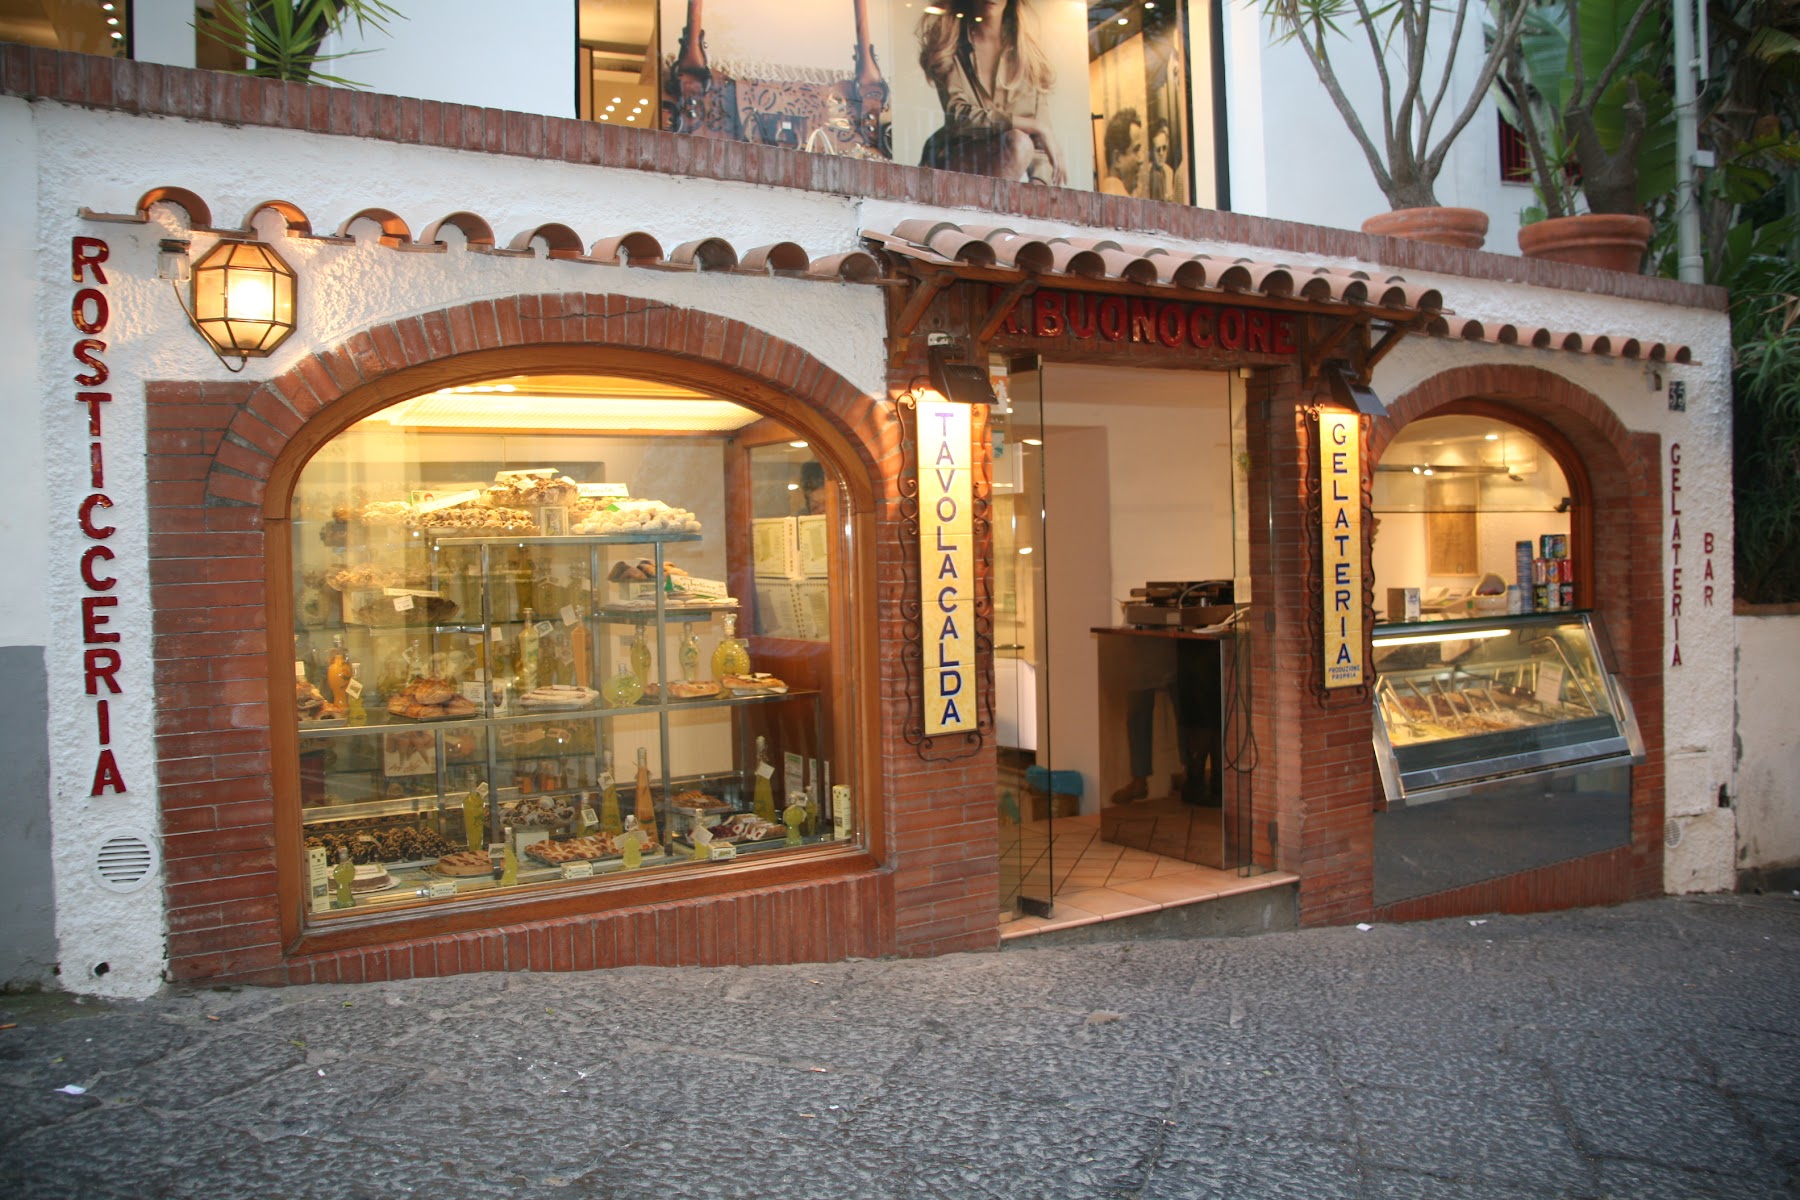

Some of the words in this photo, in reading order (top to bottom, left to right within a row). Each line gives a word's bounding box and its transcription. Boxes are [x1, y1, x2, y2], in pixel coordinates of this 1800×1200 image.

[1033, 290, 1297, 354] BUONOCORE
[71, 236, 126, 796] ROSTICCERIA
[1332, 423, 1351, 664] GELATERIA
[1670, 442, 1682, 667] GELATERIA
[1704, 532, 1714, 608] BAR
